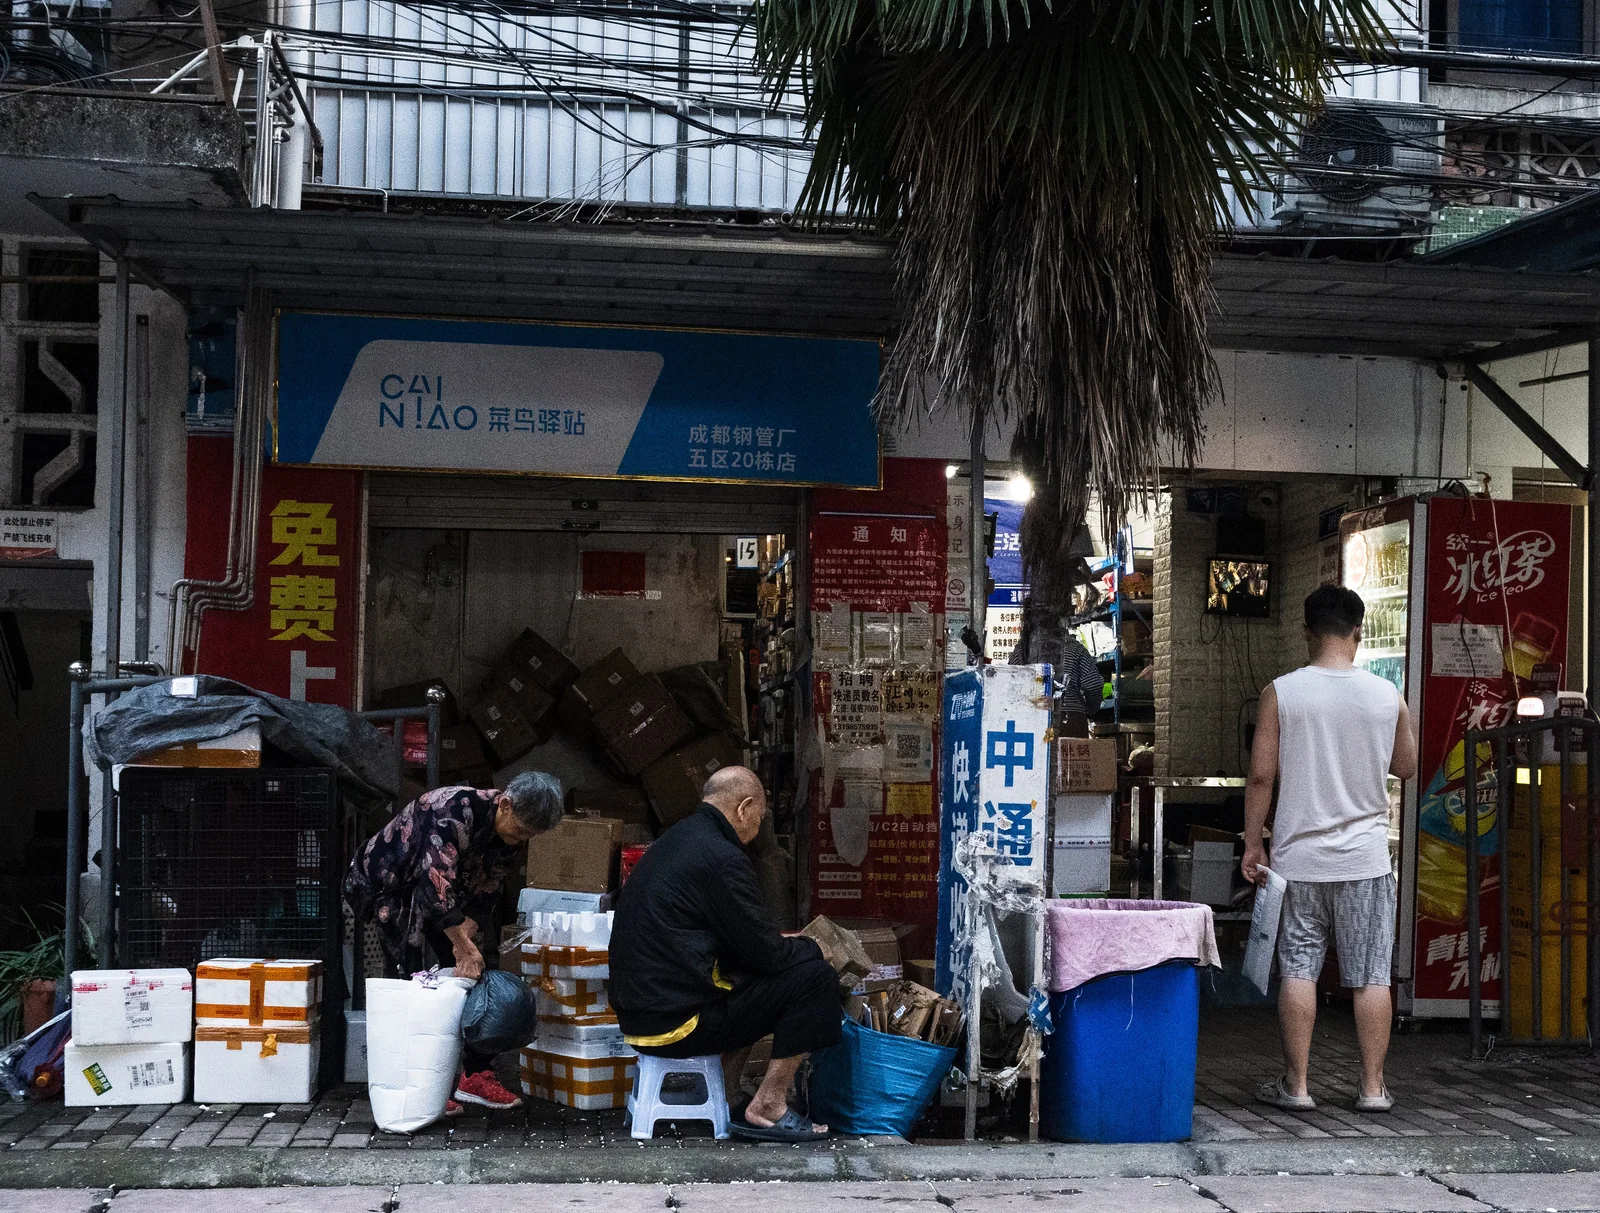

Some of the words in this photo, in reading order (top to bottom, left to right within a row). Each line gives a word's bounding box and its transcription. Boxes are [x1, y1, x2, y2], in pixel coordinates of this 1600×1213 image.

[379, 373, 442, 402] CAI
[487, 405, 586, 437] 菜鸟驿站
[687, 423, 797, 449] 成都钢管厂
[687, 448, 797, 474] 五区20栋店
[3, 516, 54, 527] 此处禁止停车
[851, 525, 908, 543] 通知
[740, 541, 756, 560] 15
[1443, 530, 1556, 606] 冰红茶
[1476, 591, 1497, 604] Ice
[838, 671, 875, 687] 招聘
[832, 689, 880, 703] 快递员数名
